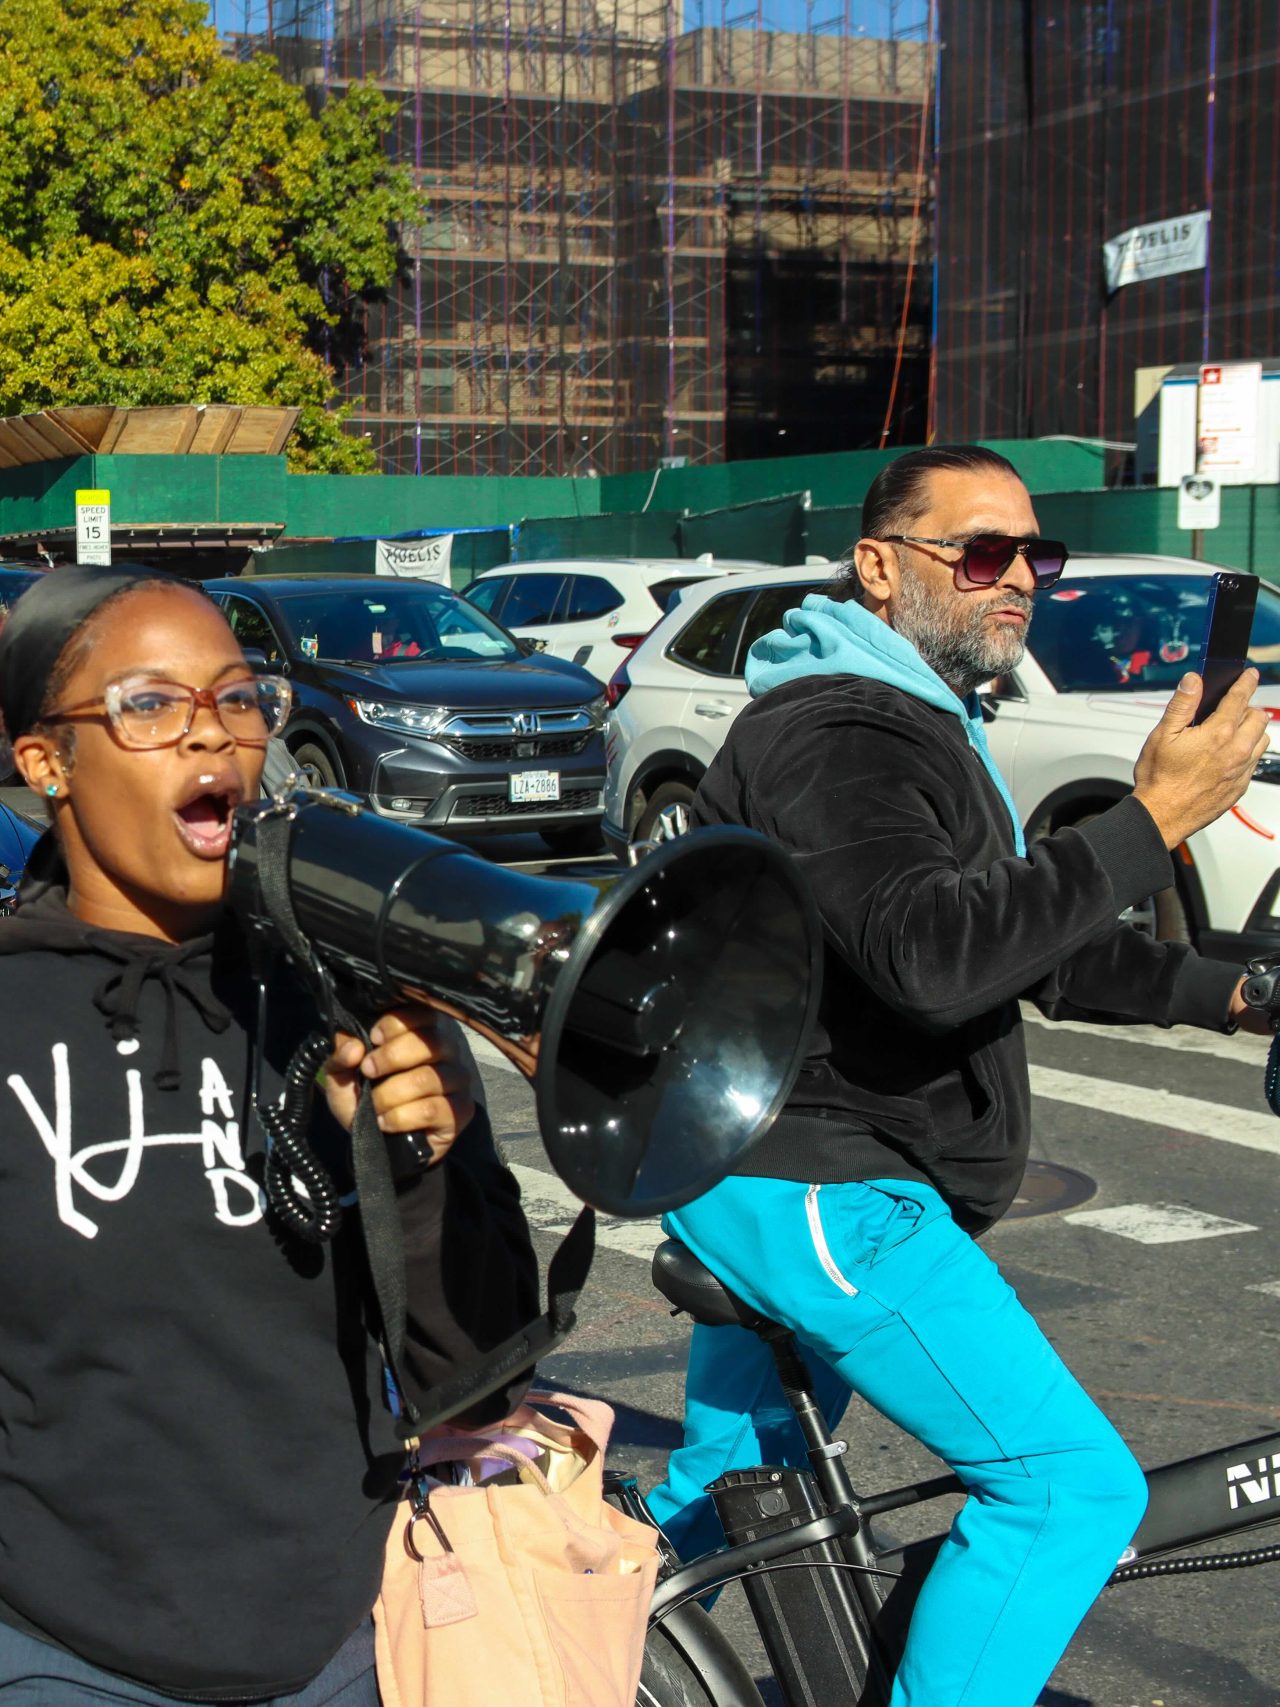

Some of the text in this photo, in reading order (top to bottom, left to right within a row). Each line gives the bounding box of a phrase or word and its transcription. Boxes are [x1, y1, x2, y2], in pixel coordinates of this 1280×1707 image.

[80, 506, 106, 514] SPEED
[83, 515, 102, 523] LIMIT
[86, 526, 101, 539] 15
